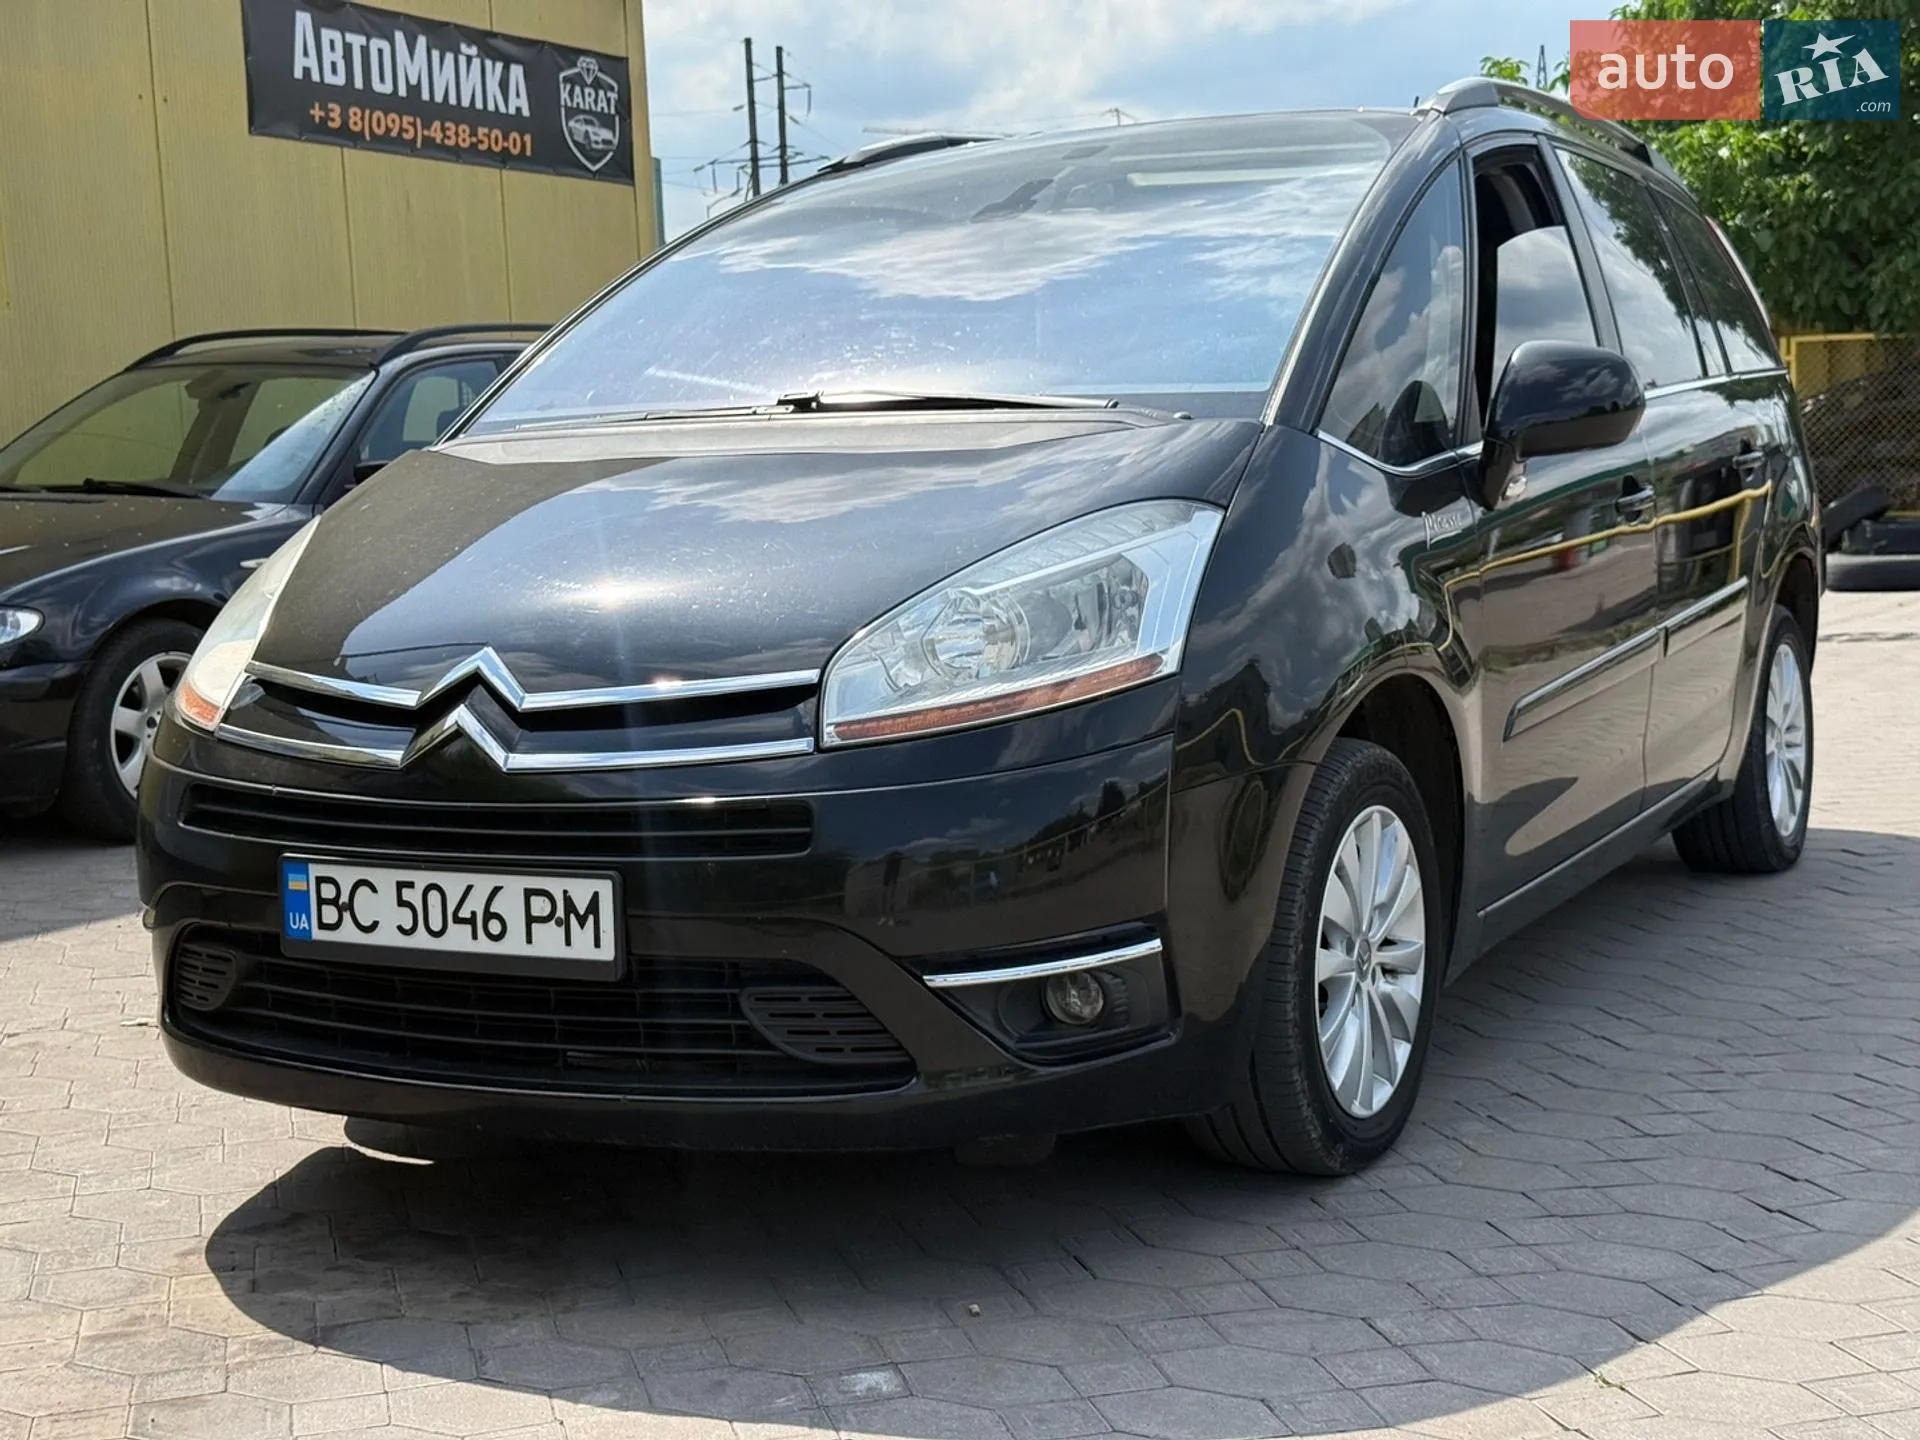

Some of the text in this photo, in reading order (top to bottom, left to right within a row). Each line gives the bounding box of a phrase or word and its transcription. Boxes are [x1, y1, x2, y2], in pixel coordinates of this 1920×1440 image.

[561, 83, 618, 115] KARAT
[289, 912, 309, 931] UA
[315, 874, 601, 949] BC 5046 PM
